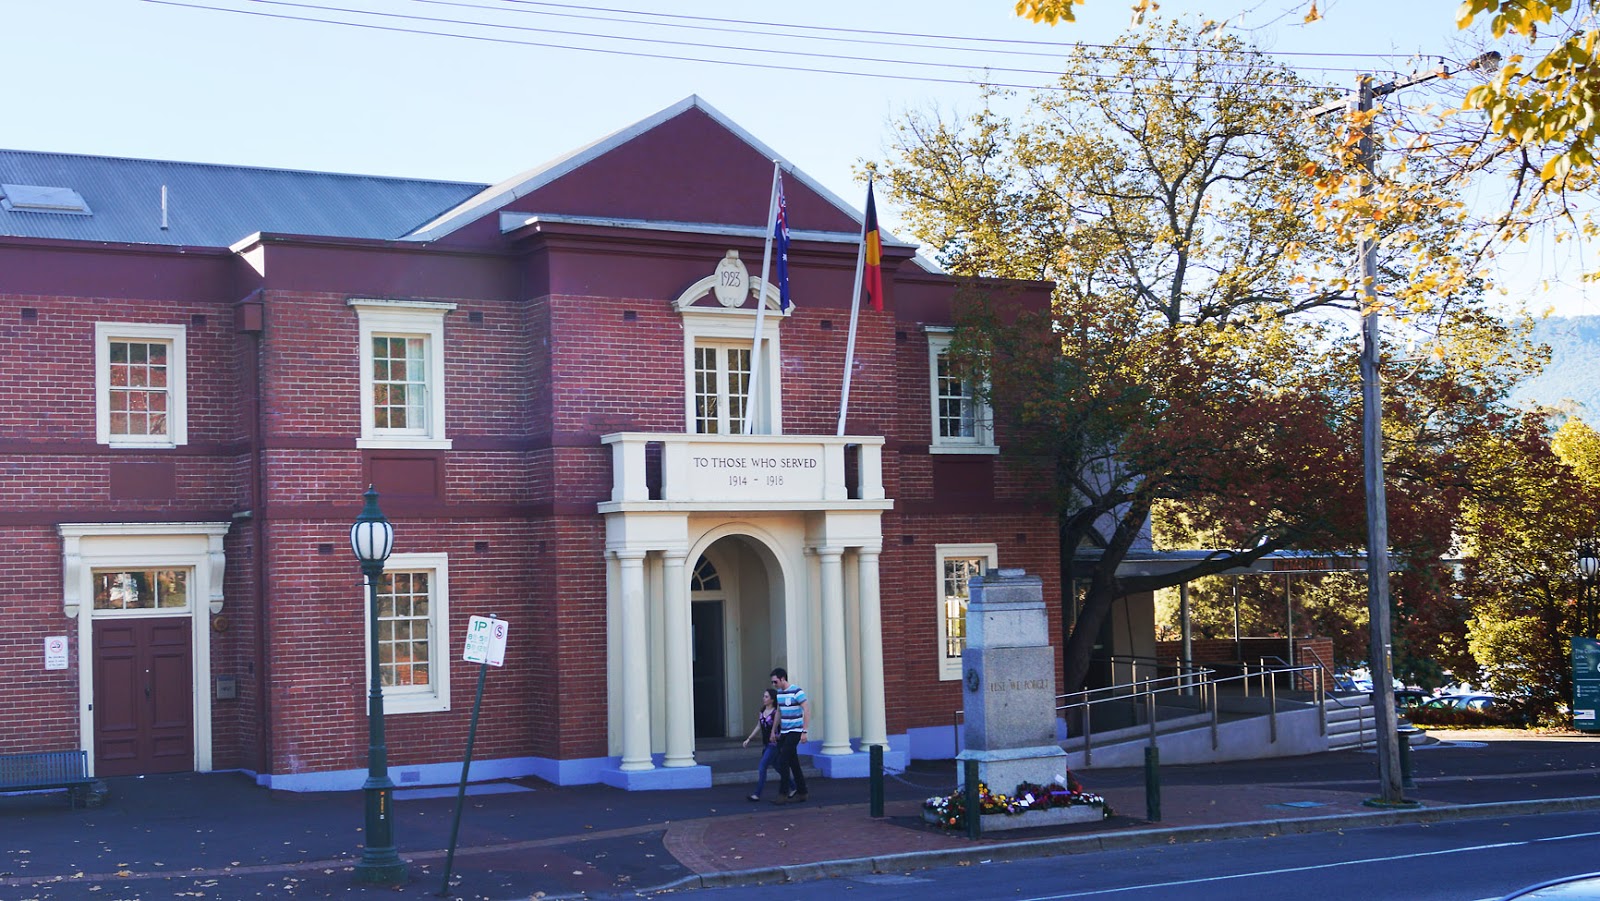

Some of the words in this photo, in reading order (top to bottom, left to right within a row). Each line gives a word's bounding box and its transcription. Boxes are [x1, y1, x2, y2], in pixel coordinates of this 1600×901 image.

[720, 270, 741, 288] 1923
[693, 457, 709, 468] TO
[711, 457, 747, 468] THOSE
[751, 458, 777, 468] WHO
[780, 458, 817, 469] SERVED
[729, 475, 748, 487] 1914
[766, 475, 784, 486] 1918
[474, 620, 488, 632] 1P
[990, 681, 1006, 692] LEST
[1010, 680, 1021, 690] WE
[1024, 679, 1049, 690] FORGET
